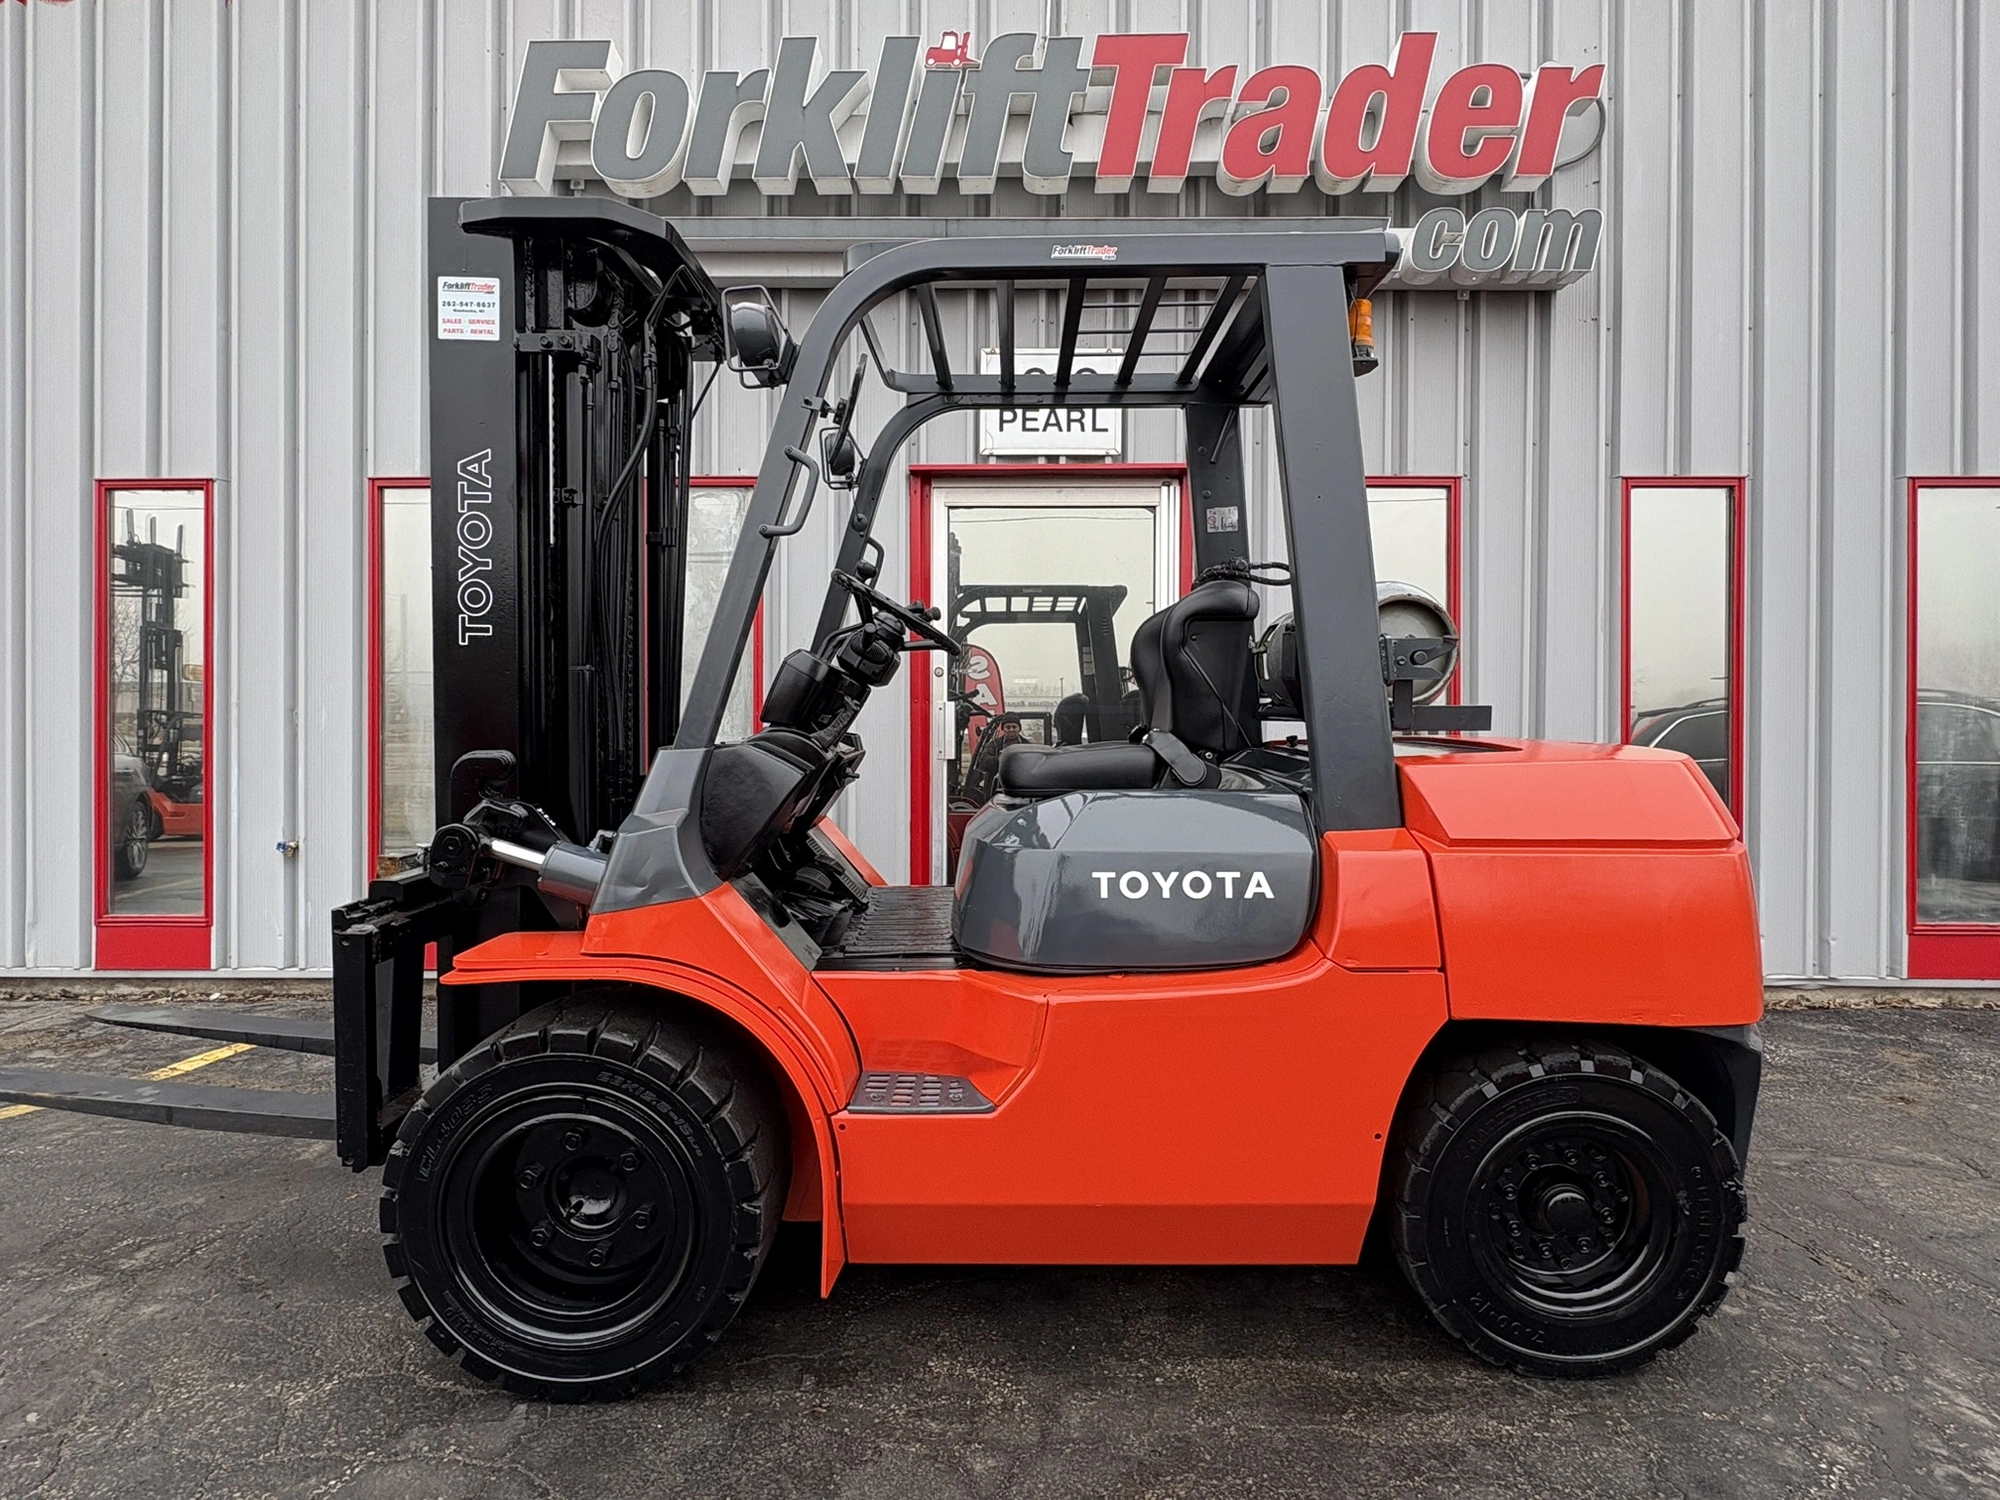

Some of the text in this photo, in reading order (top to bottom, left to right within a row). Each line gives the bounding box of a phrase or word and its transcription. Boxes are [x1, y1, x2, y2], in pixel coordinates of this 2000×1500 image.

[499, 31, 1605, 186] ForkliftTrader
[1053, 246, 1117, 254] ForkliftTrader
[1397, 208, 1603, 272] com
[443, 281, 496, 290] ForkliftTrader
[998, 408, 1109, 433] PEARL
[457, 447, 493, 646] TOYOTA
[1091, 870, 1276, 900] TOYOTA
